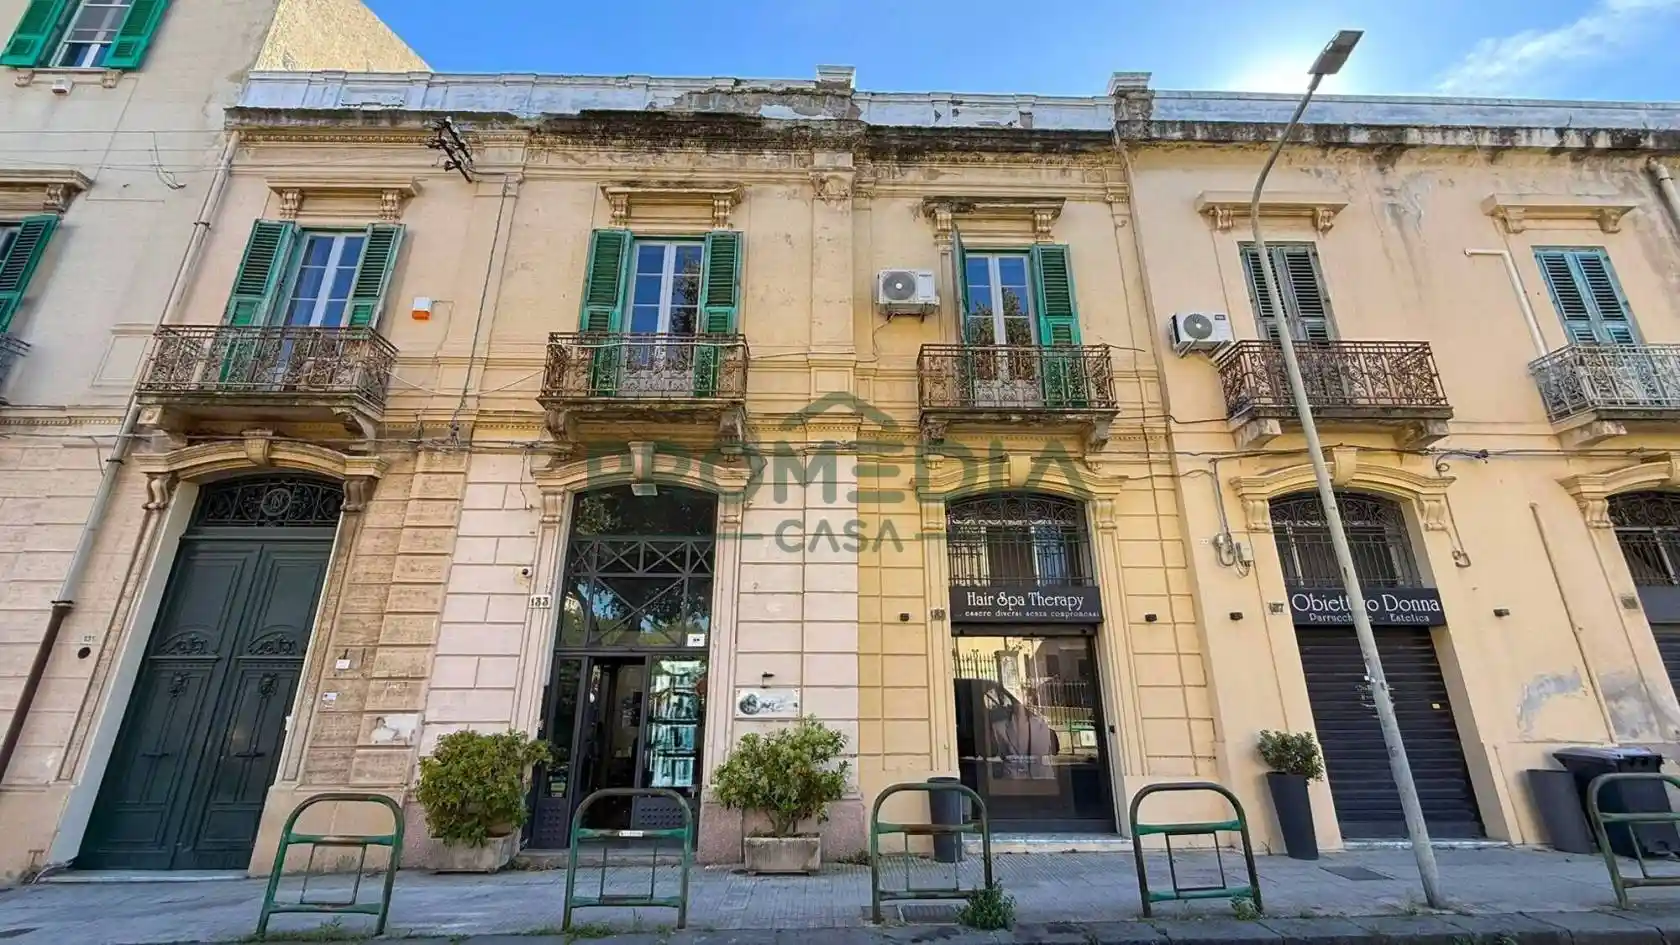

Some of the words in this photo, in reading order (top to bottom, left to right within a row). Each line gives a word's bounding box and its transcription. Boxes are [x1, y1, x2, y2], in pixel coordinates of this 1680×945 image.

[530, 596, 549, 608] 133
[966, 591, 994, 606] Hair
[996, 591, 1026, 610] Spa
[1027, 591, 1084, 611] Therapy
[1292, 592, 1380, 612] Obietto
[1382, 593, 1440, 612] Donna
[1389, 612, 1430, 623] Estetica
